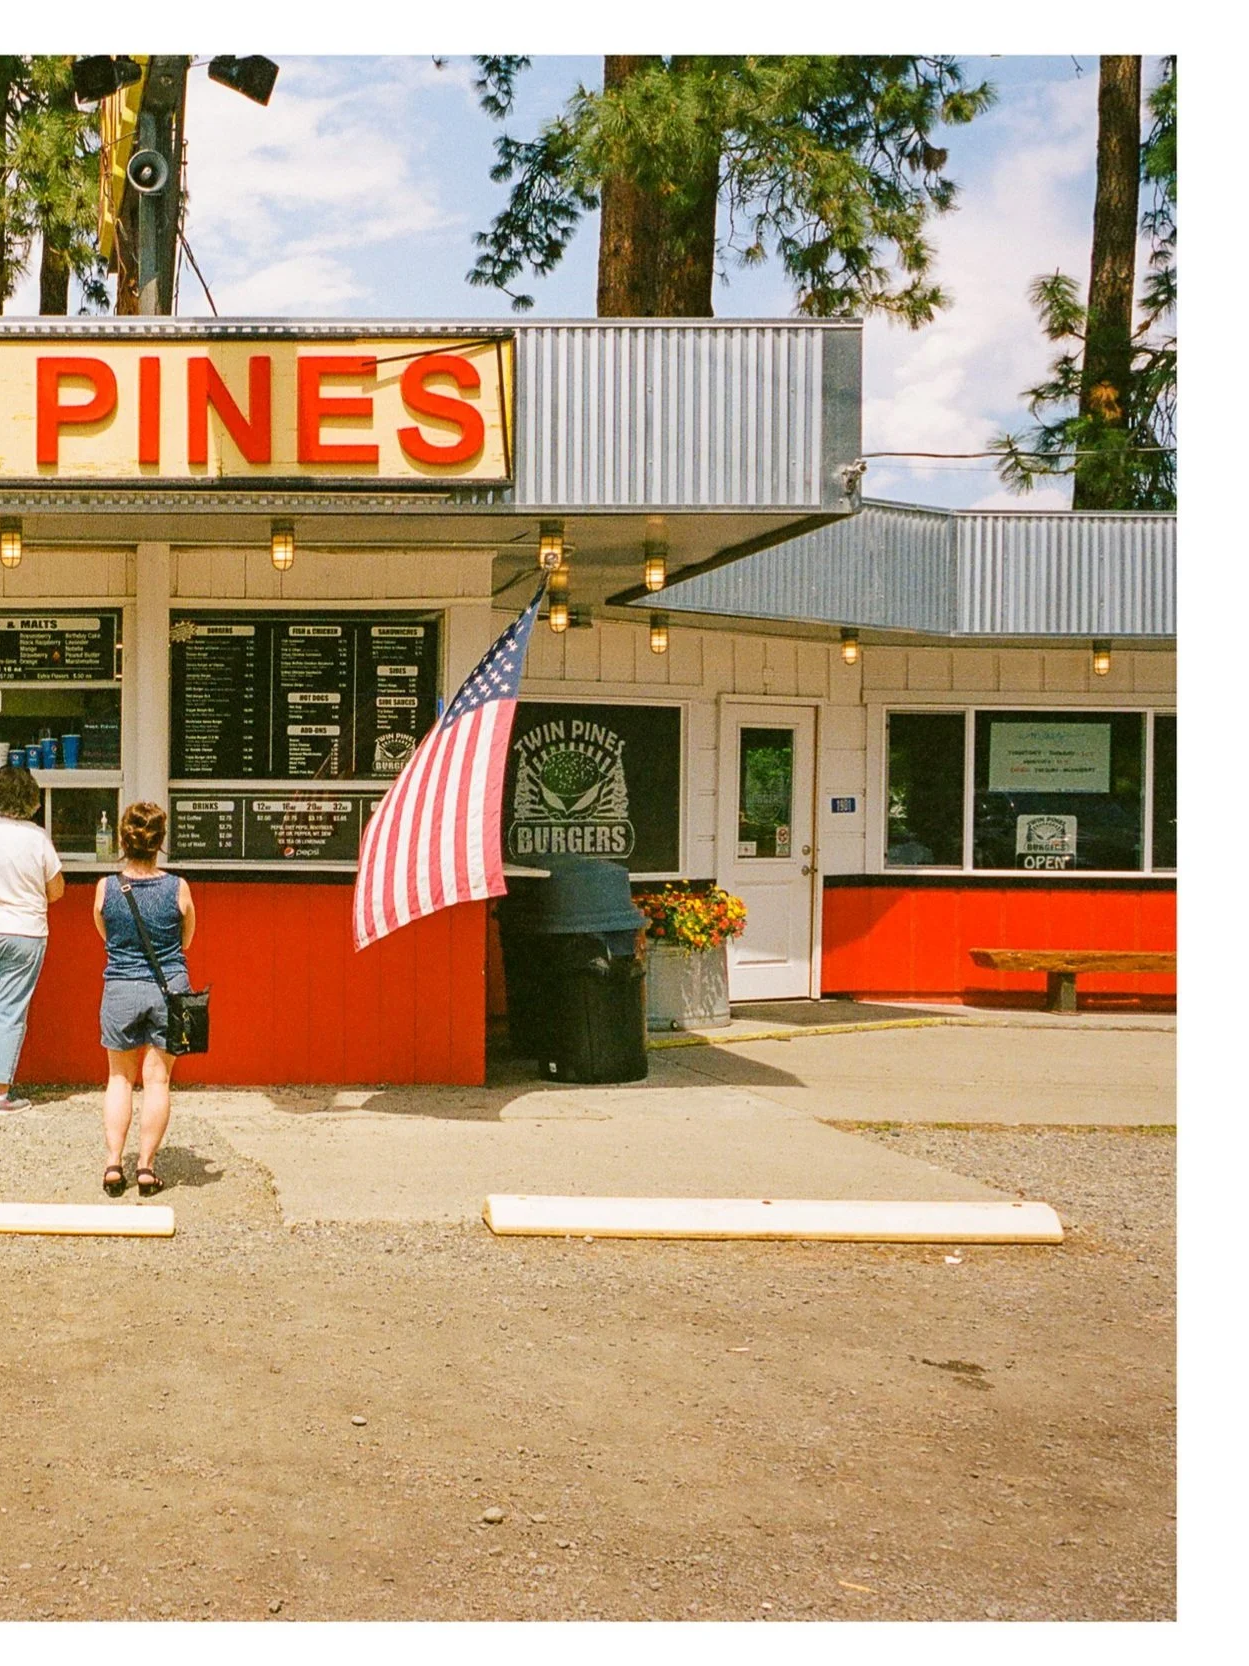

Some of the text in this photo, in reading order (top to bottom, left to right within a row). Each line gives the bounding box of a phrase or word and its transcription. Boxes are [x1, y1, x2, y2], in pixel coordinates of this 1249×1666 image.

[36, 354, 485, 467] PINES
[20, 620, 58, 629] MALTS
[514, 720, 626, 757] TWIN PINES
[192, 802, 219, 810] DRINKS
[517, 826, 626, 855] BURGERS
[1024, 856, 1066, 870] OPEN
